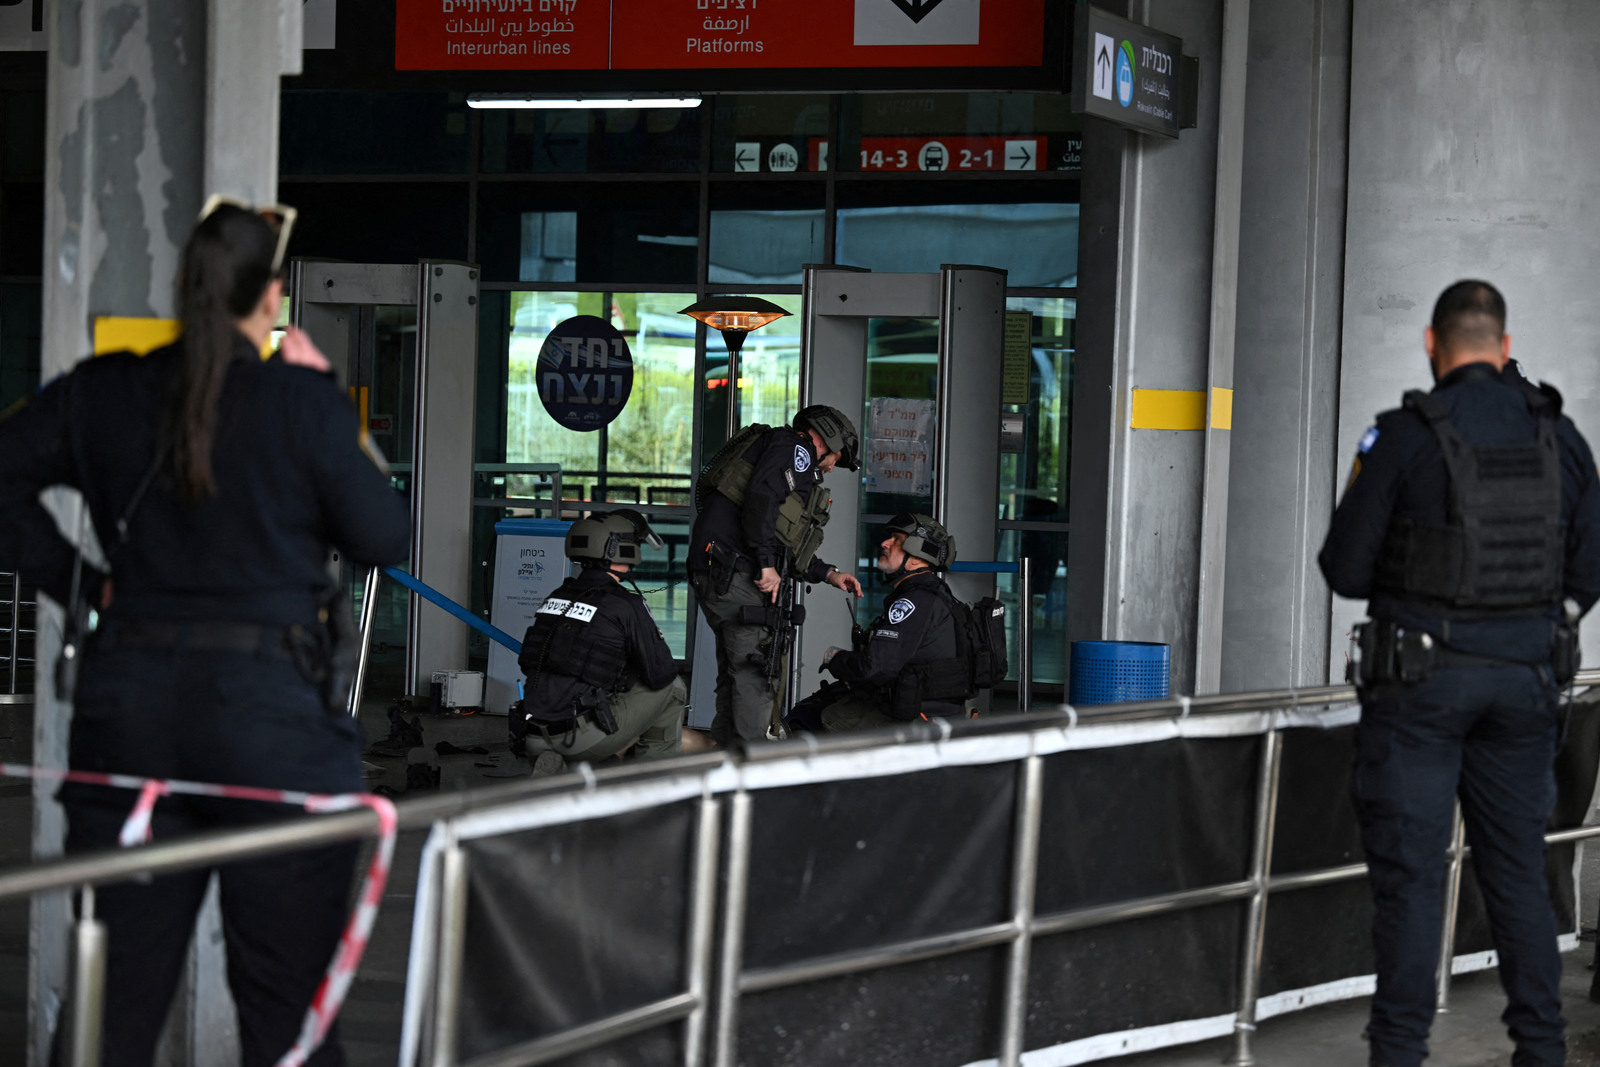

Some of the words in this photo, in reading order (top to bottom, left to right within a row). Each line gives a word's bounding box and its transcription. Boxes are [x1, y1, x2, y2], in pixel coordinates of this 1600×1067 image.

[539, 0, 577, 15] קוים
[445, 18, 495, 36] البلدات
[500, 21, 523, 37] بين
[527, 18, 575, 37] خطوط
[447, 40, 527, 55] Interurban
[533, 40, 571, 55] lines
[686, 38, 764, 53] Platforms
[1141, 44, 1172, 76] רכבלית
[860, 149, 908, 169] 14-3
[959, 149, 993, 168] 2-1
[561, 336, 623, 369] יחד
[542, 371, 623, 406] ננצח
[888, 408, 916, 421] ממ"ד
[884, 427, 918, 440] ממוקם
[872, 451, 907, 463] מודיעין
[910, 451, 928, 463] ליד
[884, 470, 913, 480] חיצוני
[520, 548, 545, 559] ביטחון
